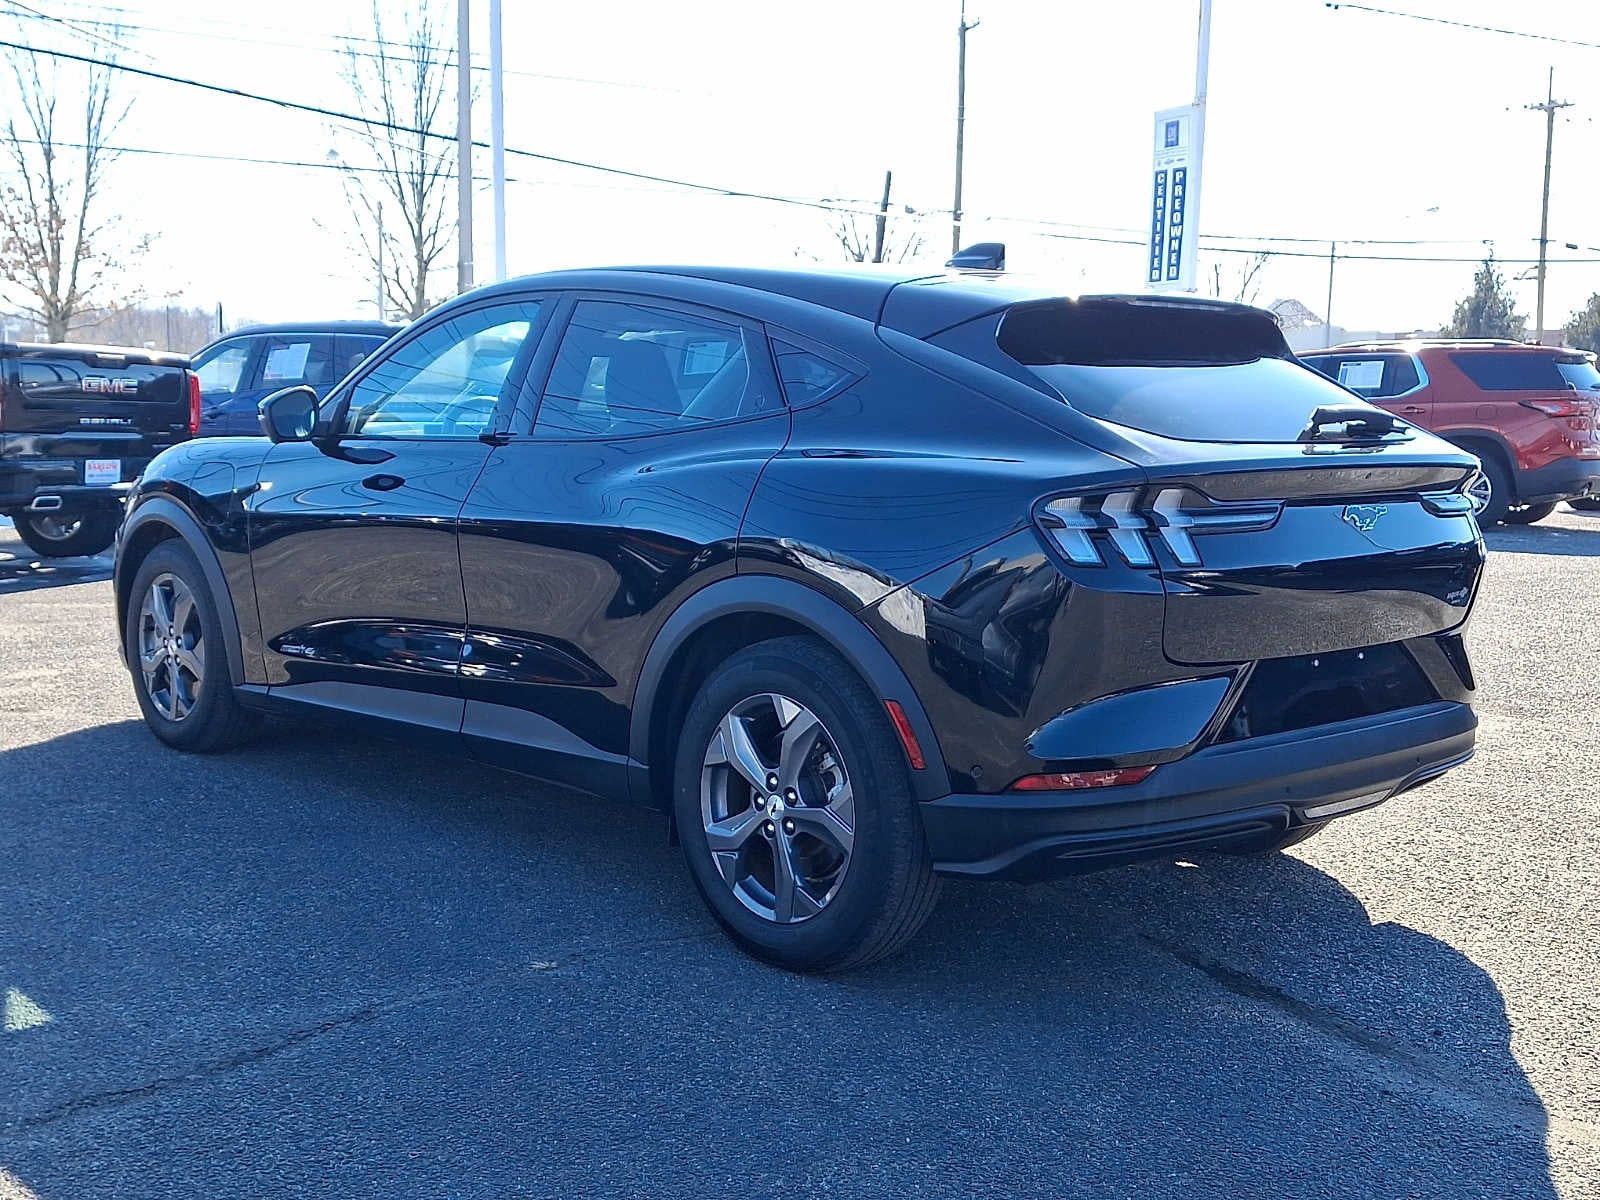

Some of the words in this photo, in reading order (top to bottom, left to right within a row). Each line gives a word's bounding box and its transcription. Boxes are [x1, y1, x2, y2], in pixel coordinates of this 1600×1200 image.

[1152, 173, 1165, 279] CERTIFIED
[1169, 171, 1183, 276] PREOWNED
[82, 377, 138, 393] GMC
